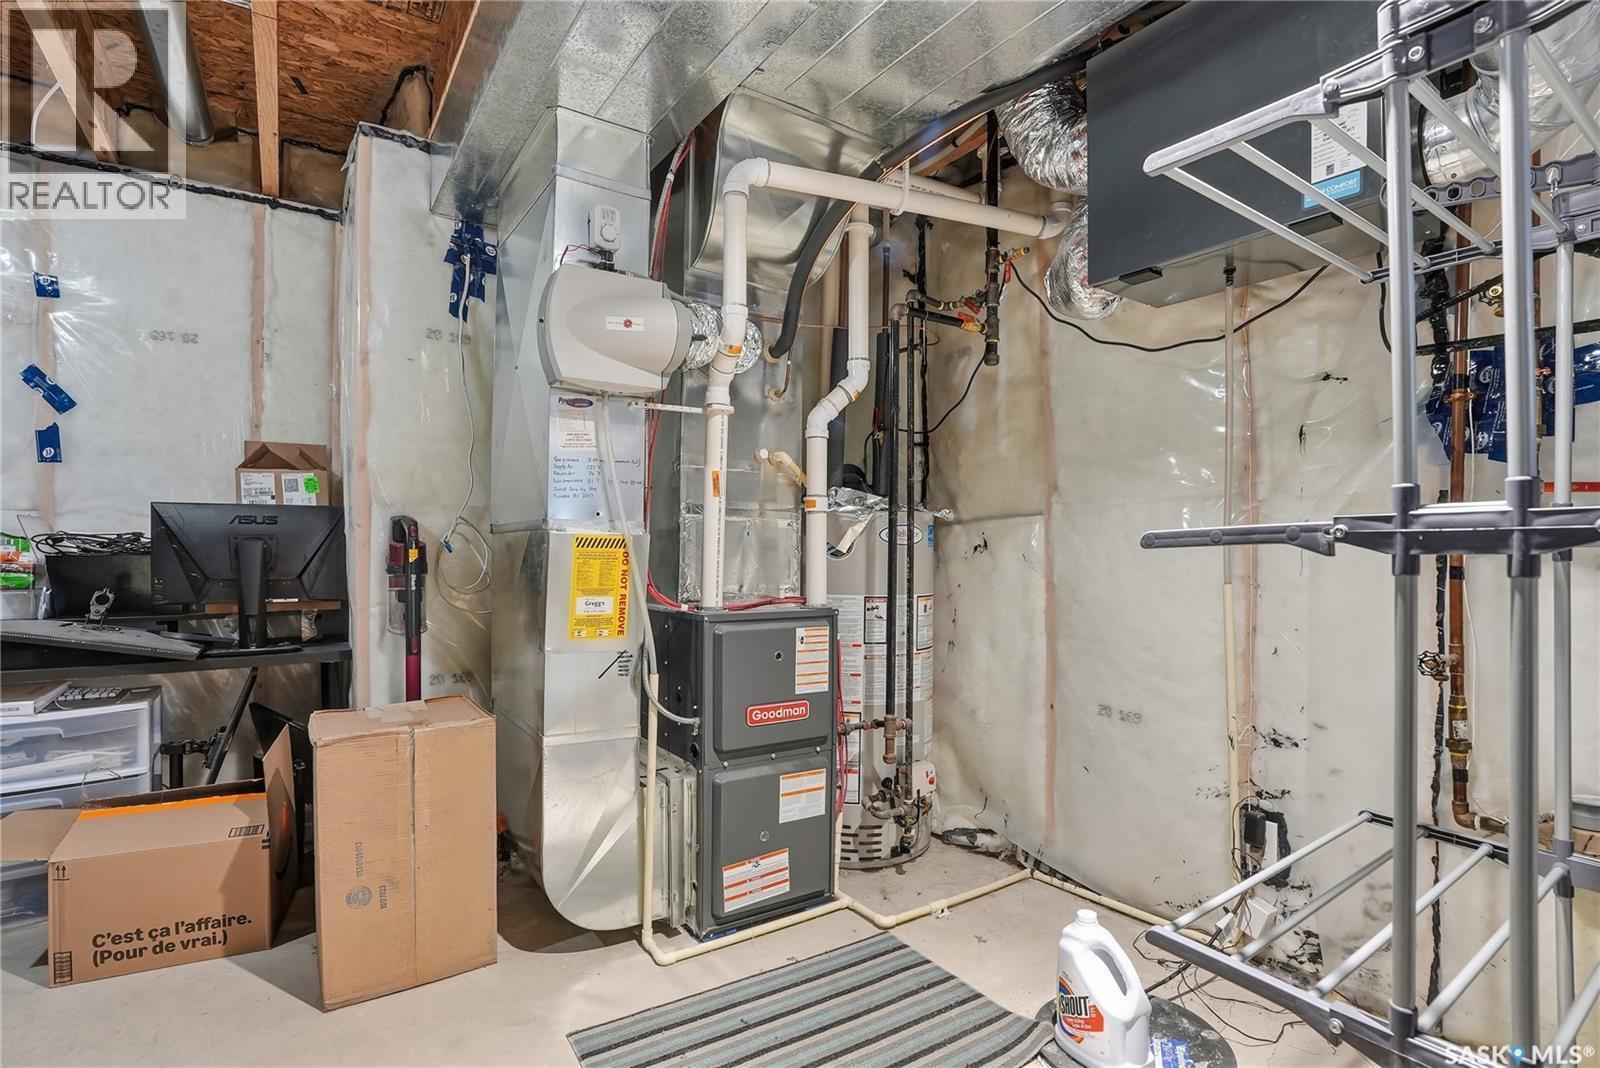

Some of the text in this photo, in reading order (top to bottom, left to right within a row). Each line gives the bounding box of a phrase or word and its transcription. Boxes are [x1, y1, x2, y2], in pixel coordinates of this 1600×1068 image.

[229, 514, 279, 525] ASUS
[616, 551, 630, 636] DO NOT REMOVE
[752, 706, 806, 721] Goodman
[1097, 704, 1142, 725] 20 169
[92, 914, 252, 949] C'est ça l'affaire.
[92, 930, 228, 968] (Pour de vrai.)
[1061, 995, 1089, 1017] SHOUT
